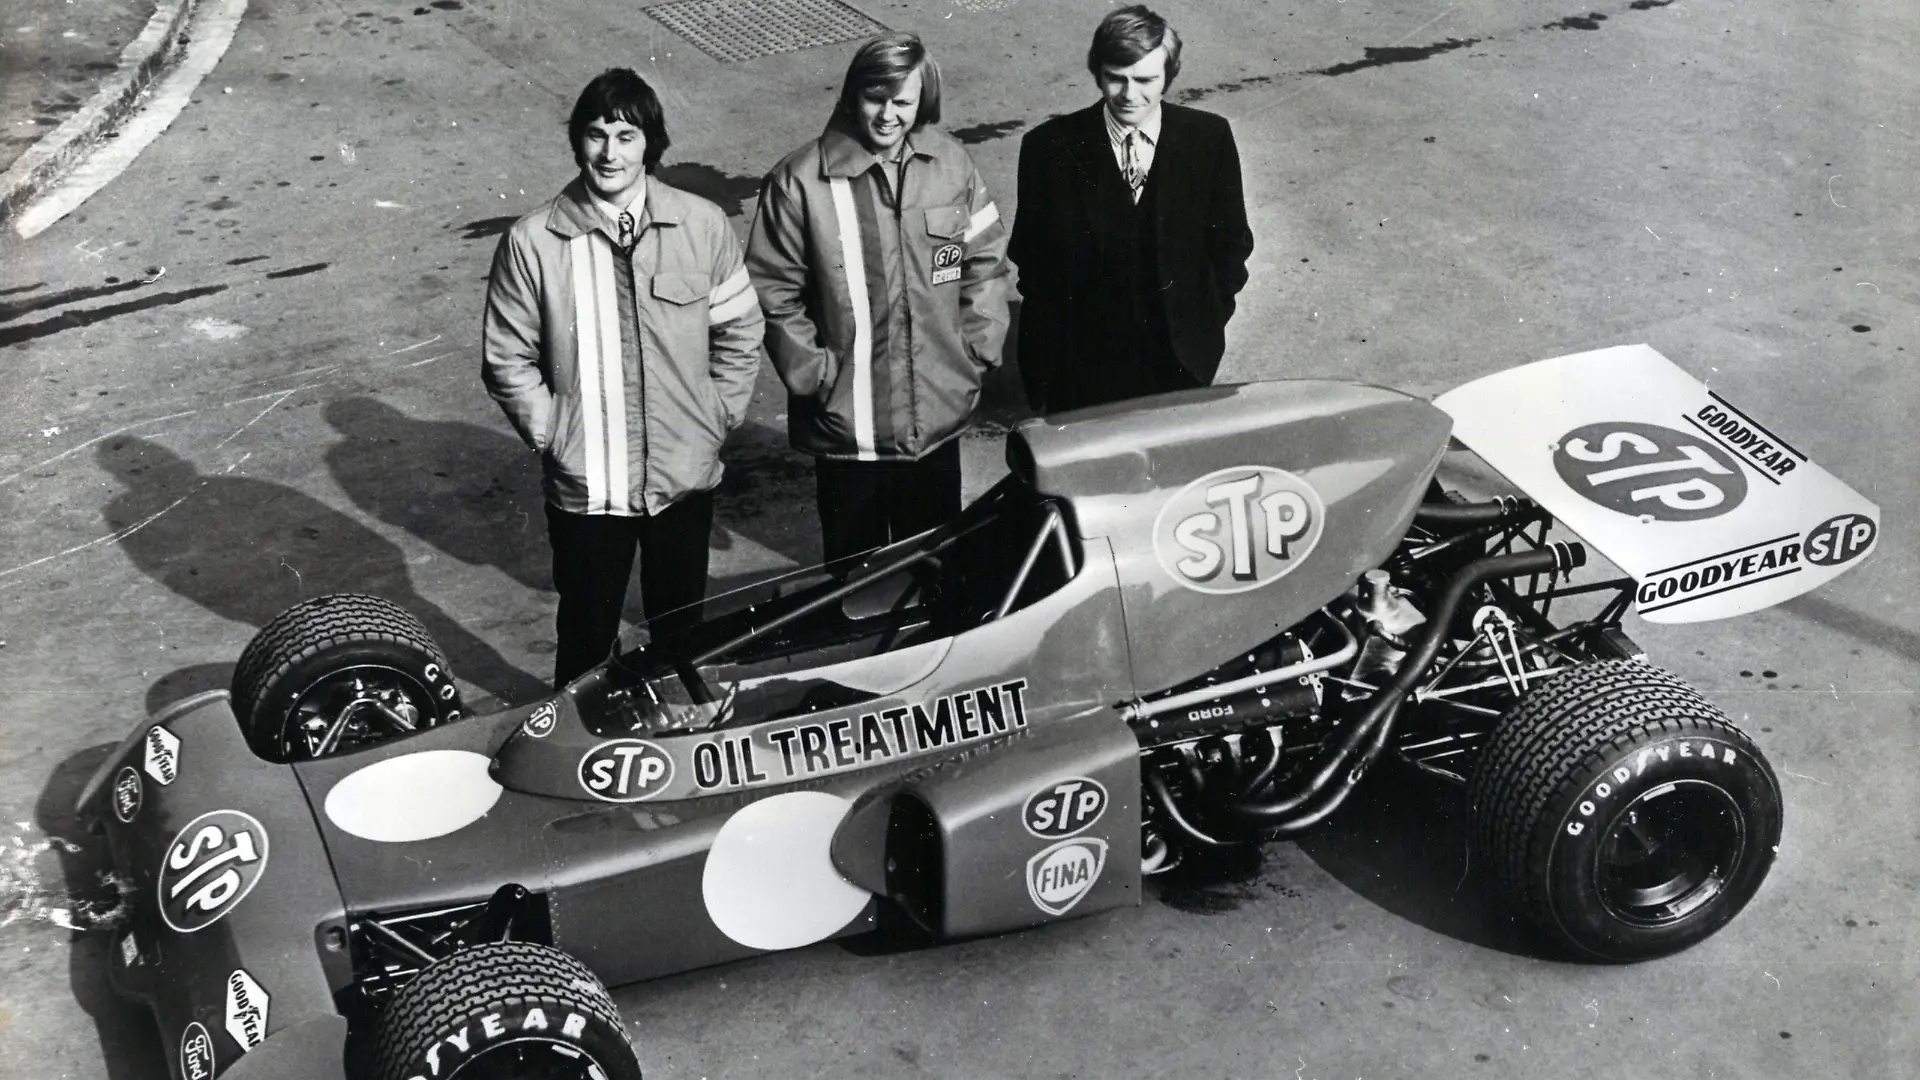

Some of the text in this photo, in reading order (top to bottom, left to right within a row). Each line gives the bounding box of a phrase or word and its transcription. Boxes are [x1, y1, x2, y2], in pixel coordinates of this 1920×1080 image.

[938, 246, 959, 265] STP
[1698, 404, 1796, 477] GOODYEAR
[1565, 431, 1734, 510] STP
[1174, 472, 1312, 582] STP
[1808, 516, 1872, 560] STP
[1638, 542, 1801, 604] GOODYEAR
[530, 706, 553, 729] STP
[692, 678, 1029, 790] OIL TREATMENT
[1188, 704, 1234, 722] FORD
[117, 775, 139, 814] Ford
[588, 746, 666, 795] STP
[1032, 782, 1101, 831] STP
[169, 824, 260, 912] STP
[1040, 857, 1089, 893] FINA
[184, 1034, 210, 1080] Ford
